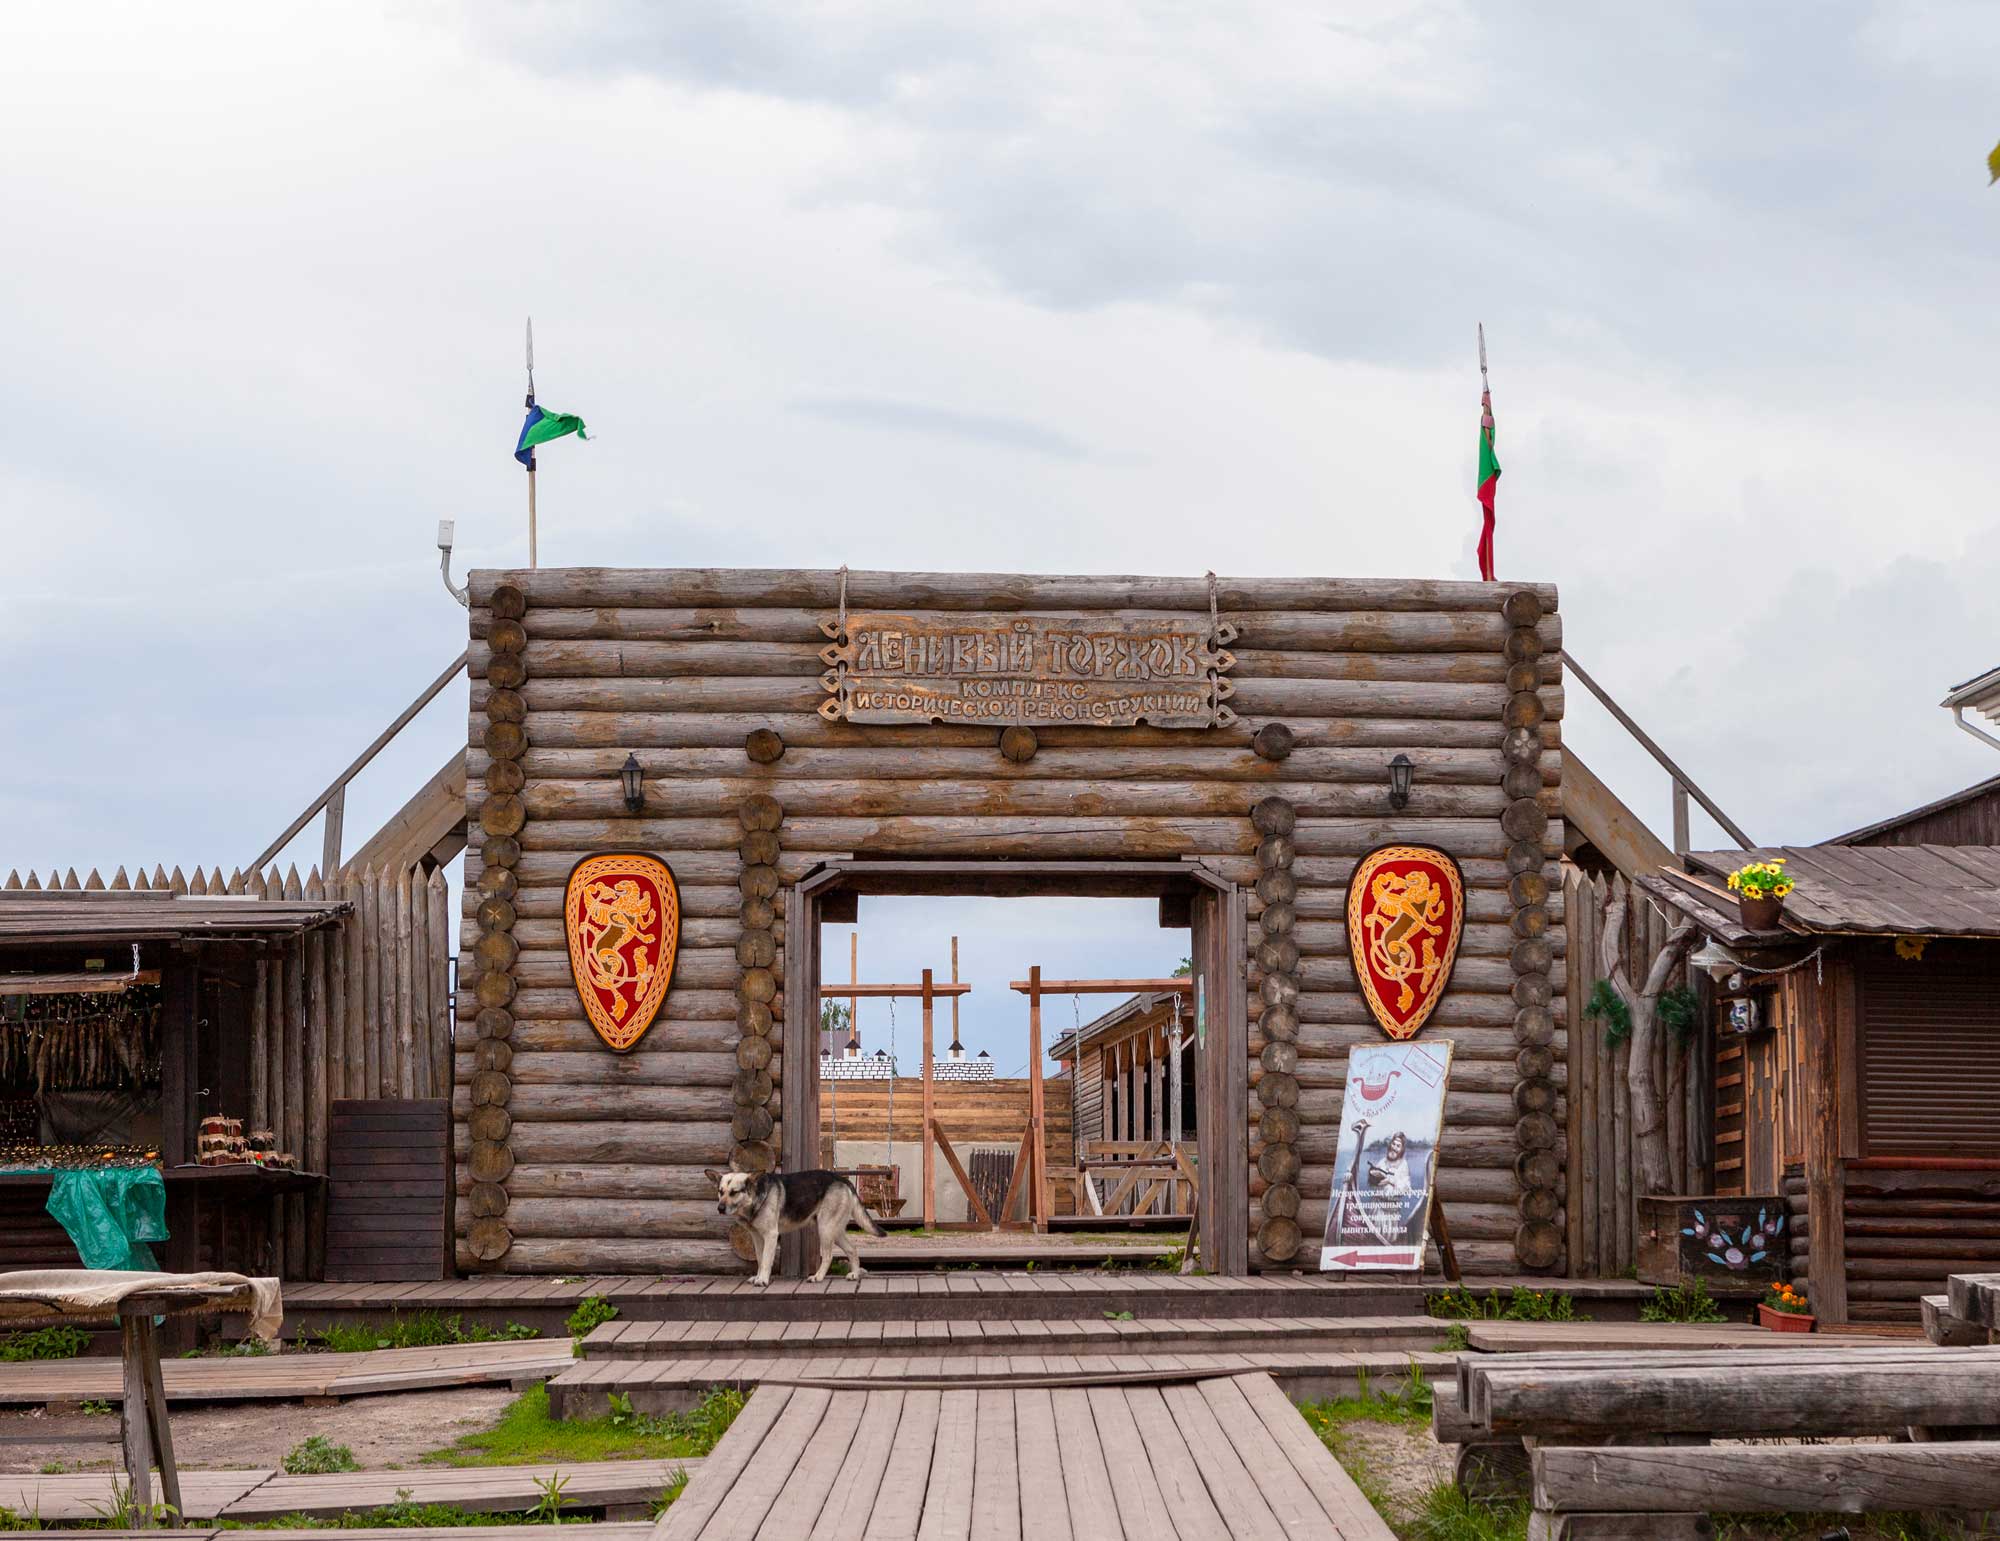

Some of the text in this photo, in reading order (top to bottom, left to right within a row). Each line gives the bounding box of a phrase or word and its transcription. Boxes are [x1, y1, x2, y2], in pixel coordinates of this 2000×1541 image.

[858, 622, 1196, 680] ЛЕНИВЫЙ ТОРЖОК
[962, 680, 1088, 701] КОМПЛЕКС
[856, 692, 1200, 720] ИСТОРИЧЕСКОЙ РЕКОНСТРУКЦИИ
